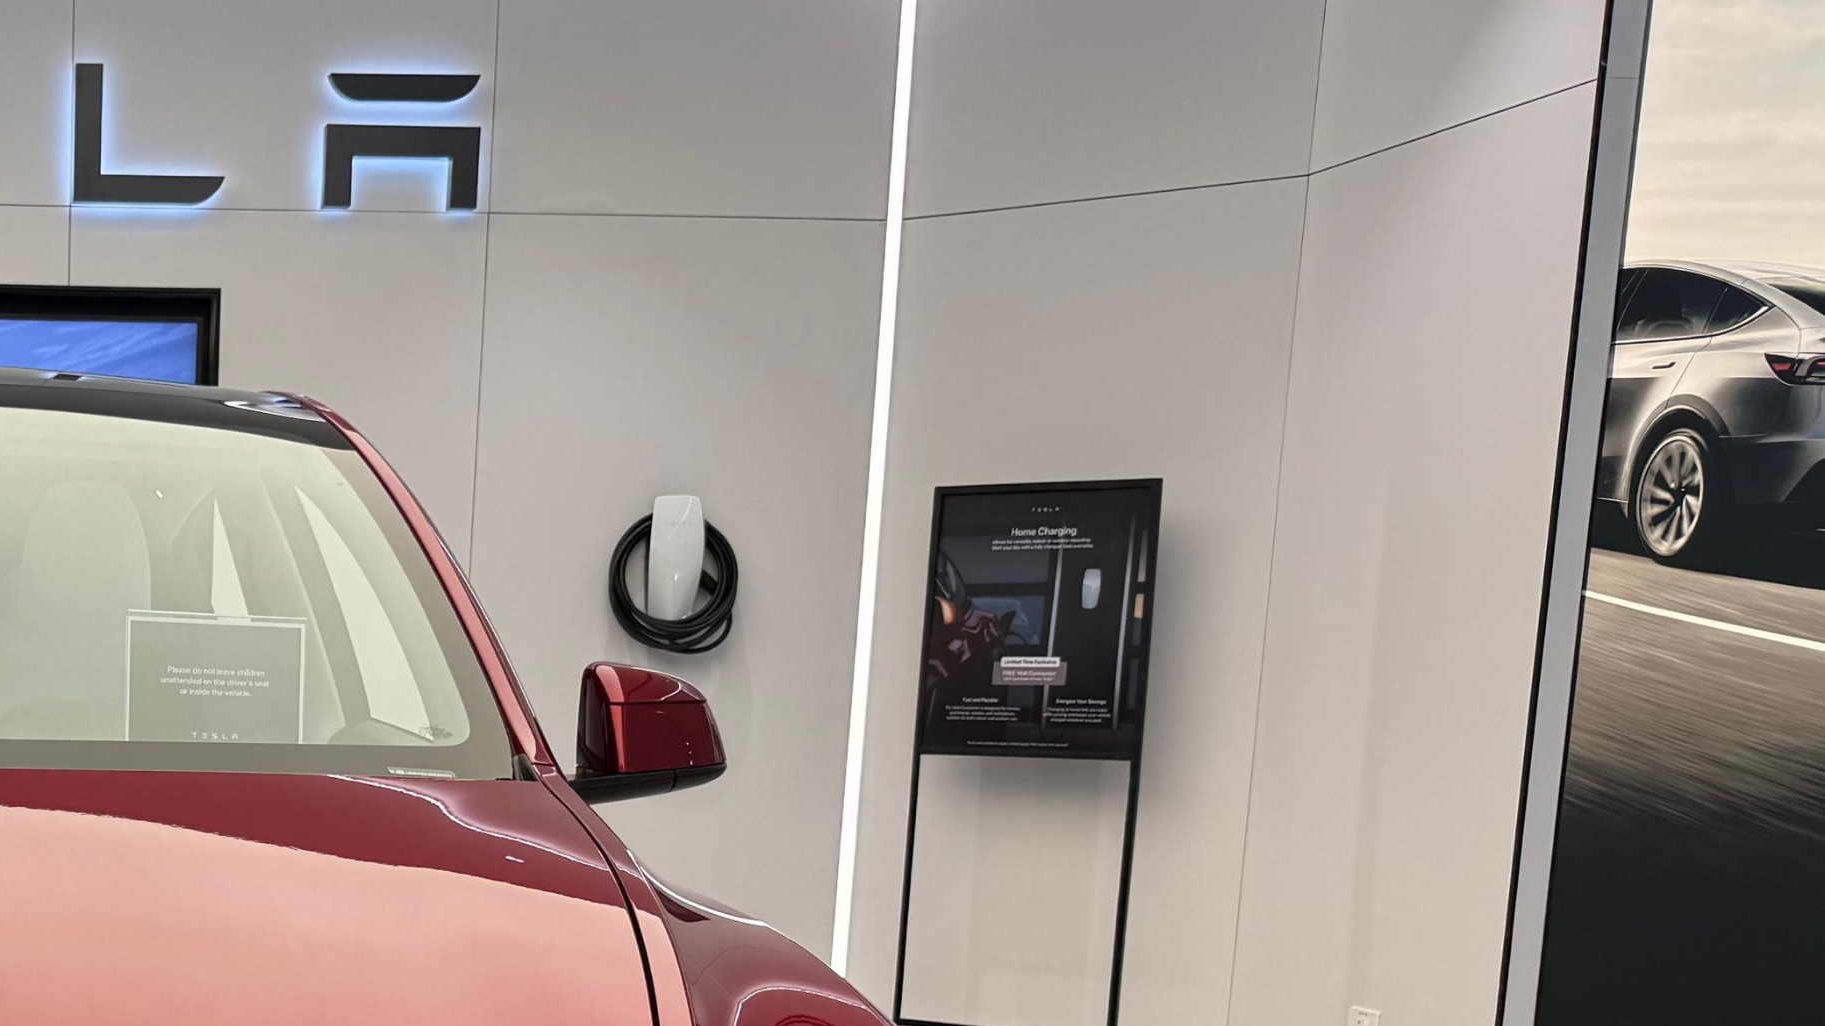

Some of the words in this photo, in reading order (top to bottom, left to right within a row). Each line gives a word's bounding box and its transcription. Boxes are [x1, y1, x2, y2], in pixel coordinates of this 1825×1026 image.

[1011, 527, 1036, 537] Home
[1038, 525, 1078, 537] Charging
[167, 665, 191, 674] Please
[192, 667, 202, 675] do
[216, 668, 235, 676] leave
[236, 669, 265, 677] children
[160, 677, 202, 685] unattended
[226, 679, 253, 687] driver's
[189, 688, 210, 696] inside
[224, 689, 251, 697] vehicle.
[191, 732, 238, 740] TESLA
